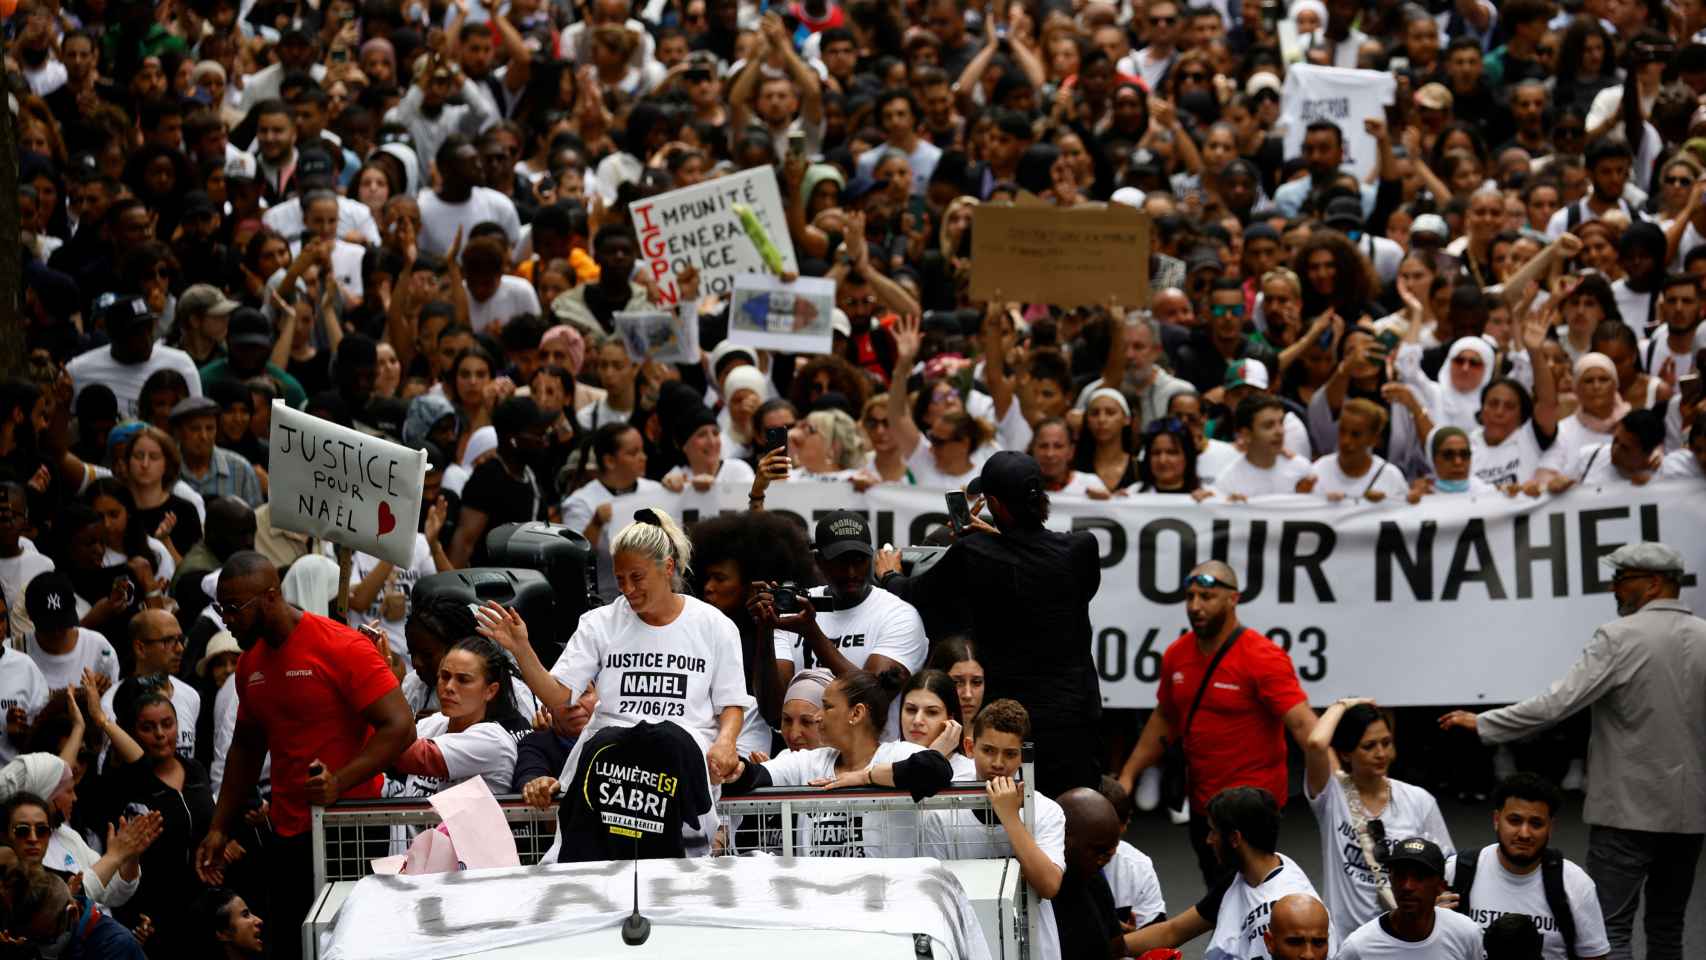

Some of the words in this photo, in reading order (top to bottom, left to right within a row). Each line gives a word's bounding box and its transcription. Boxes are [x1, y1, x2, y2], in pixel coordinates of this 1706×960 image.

[313, 471, 364, 502] POUR
[606, 653, 663, 668] JUSTICE
[667, 654, 706, 673] POUR
[623, 674, 683, 696] NAHEL
[619, 700, 685, 717] 27/06/23
[599, 782, 668, 818] SABRI
